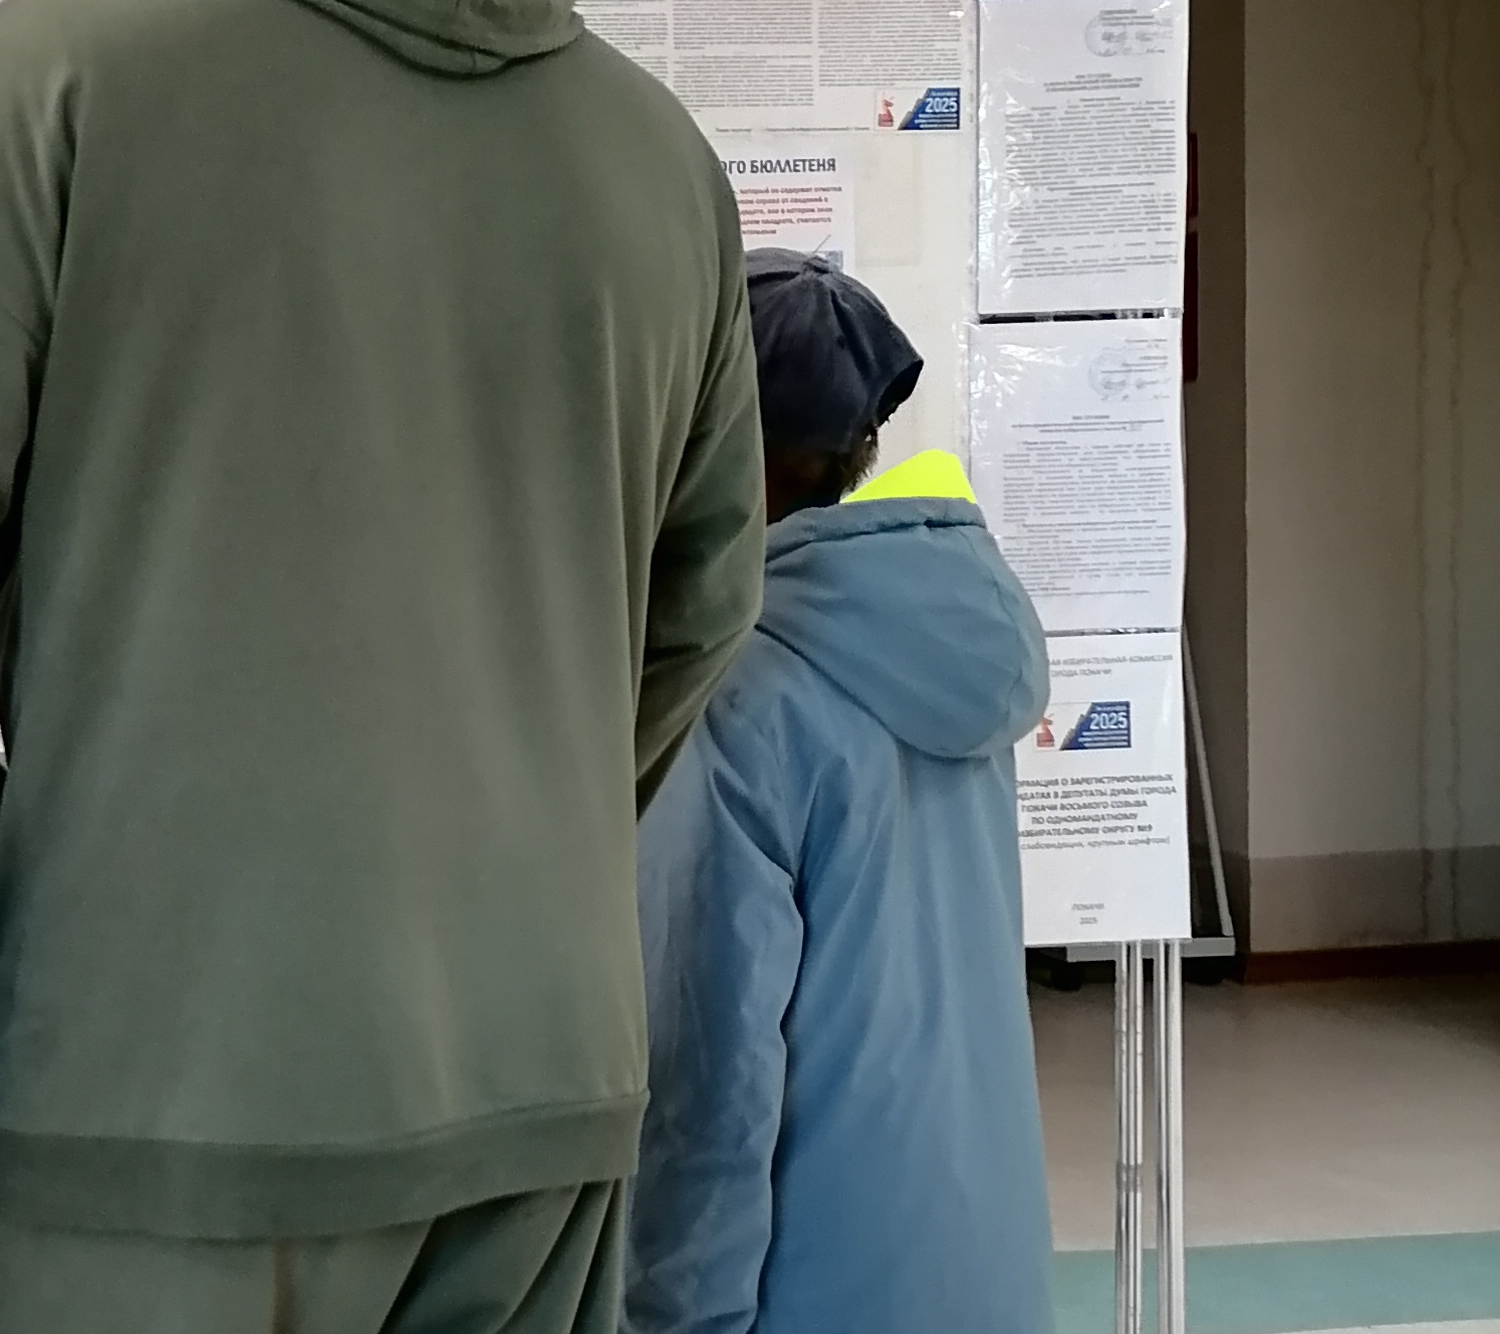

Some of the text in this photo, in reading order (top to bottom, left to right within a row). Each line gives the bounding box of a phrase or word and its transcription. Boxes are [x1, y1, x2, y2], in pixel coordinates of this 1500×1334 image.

[925, 97, 958, 113] 2025
[750, 157, 837, 174] БЮЛЛЕТЕНЯ
[1090, 712, 1128, 729] 2025
